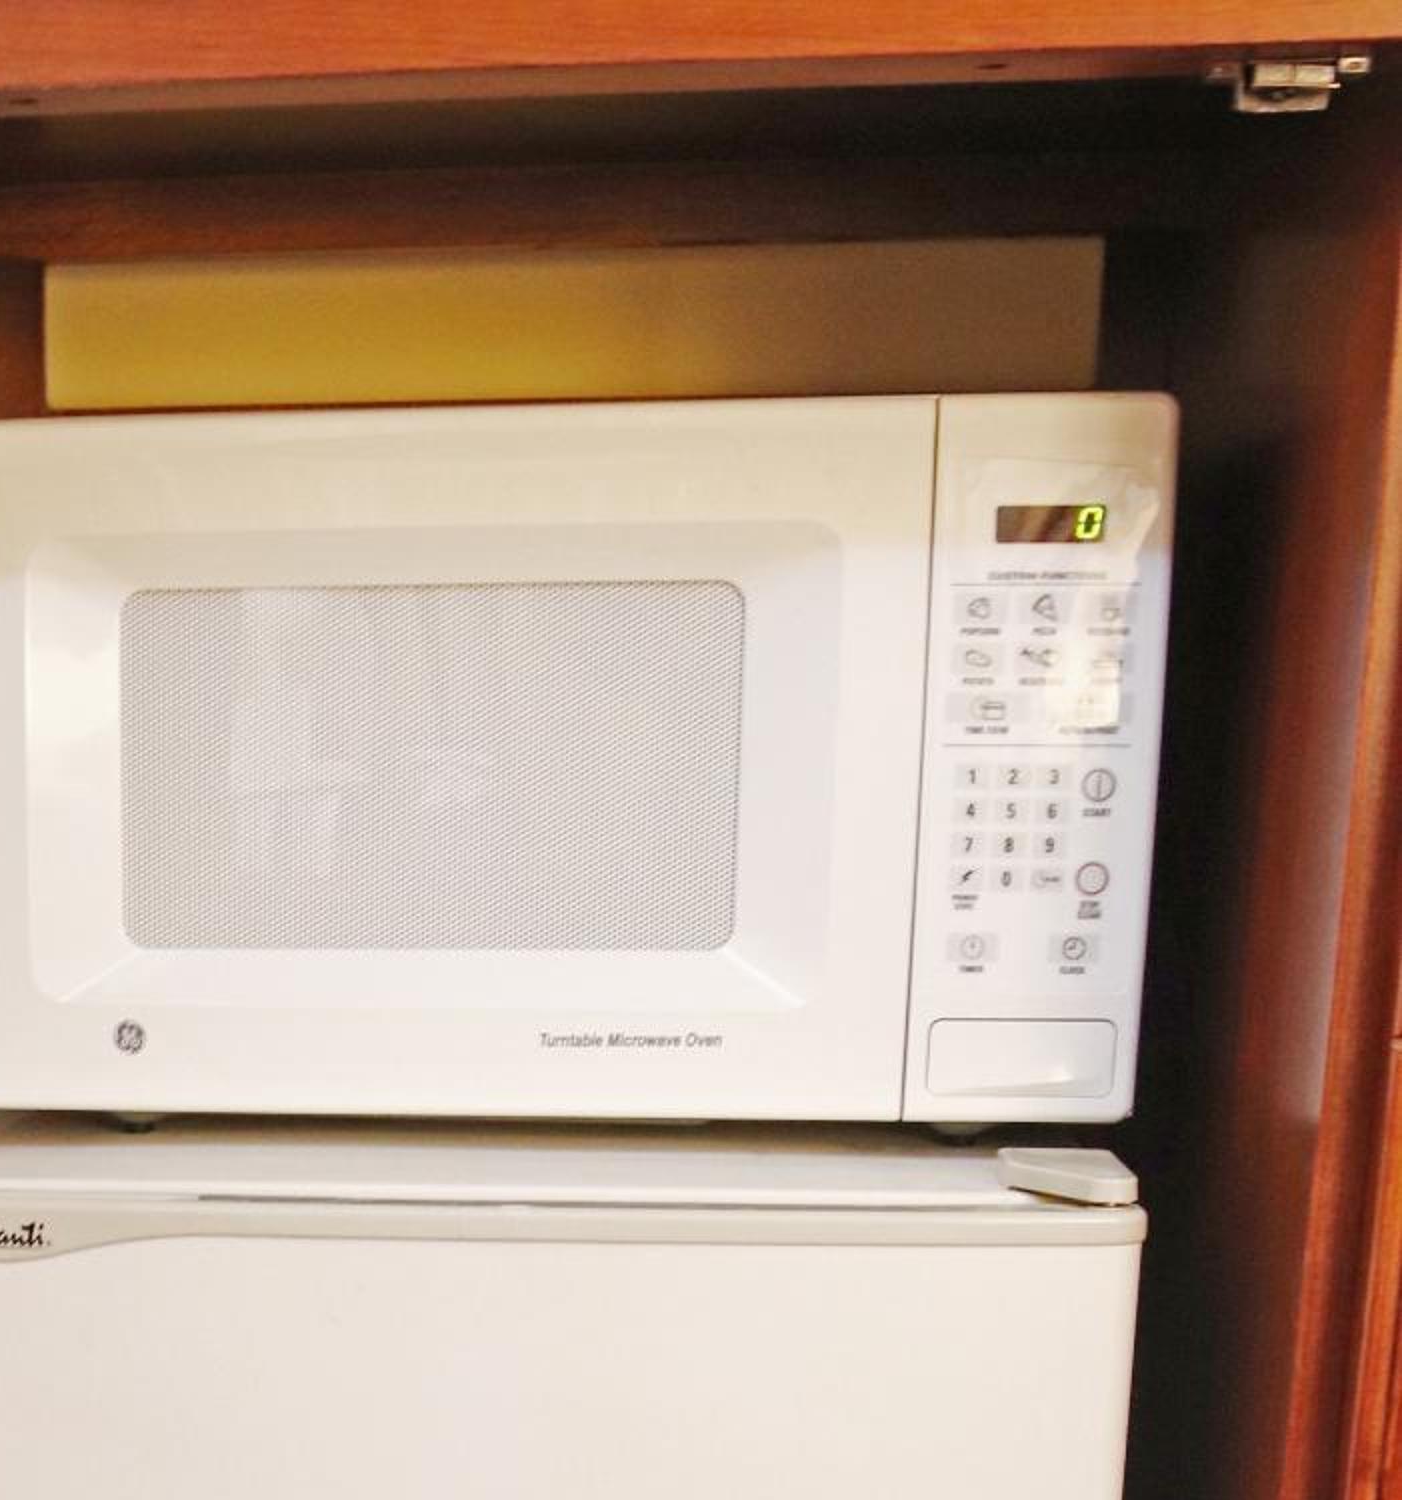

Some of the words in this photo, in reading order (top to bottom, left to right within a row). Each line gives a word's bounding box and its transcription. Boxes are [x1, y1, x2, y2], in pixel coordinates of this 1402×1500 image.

[1074, 506, 1105, 540] 0
[968, 768, 977, 785] 1
[1007, 768, 1019, 785] 2
[1048, 768, 1060, 785] 3
[965, 802, 976, 818] 4
[1006, 802, 1017, 819] 5
[1046, 802, 1058, 819] 6
[965, 836, 974, 853] 7
[1003, 836, 1014, 853] 8
[1045, 836, 1055, 853] 9
[1000, 870, 1012, 887] 0
[541, 1032, 604, 1048] Turntable
[607, 1031, 682, 1048] Microwave
[685, 1031, 724, 1048] Oven
